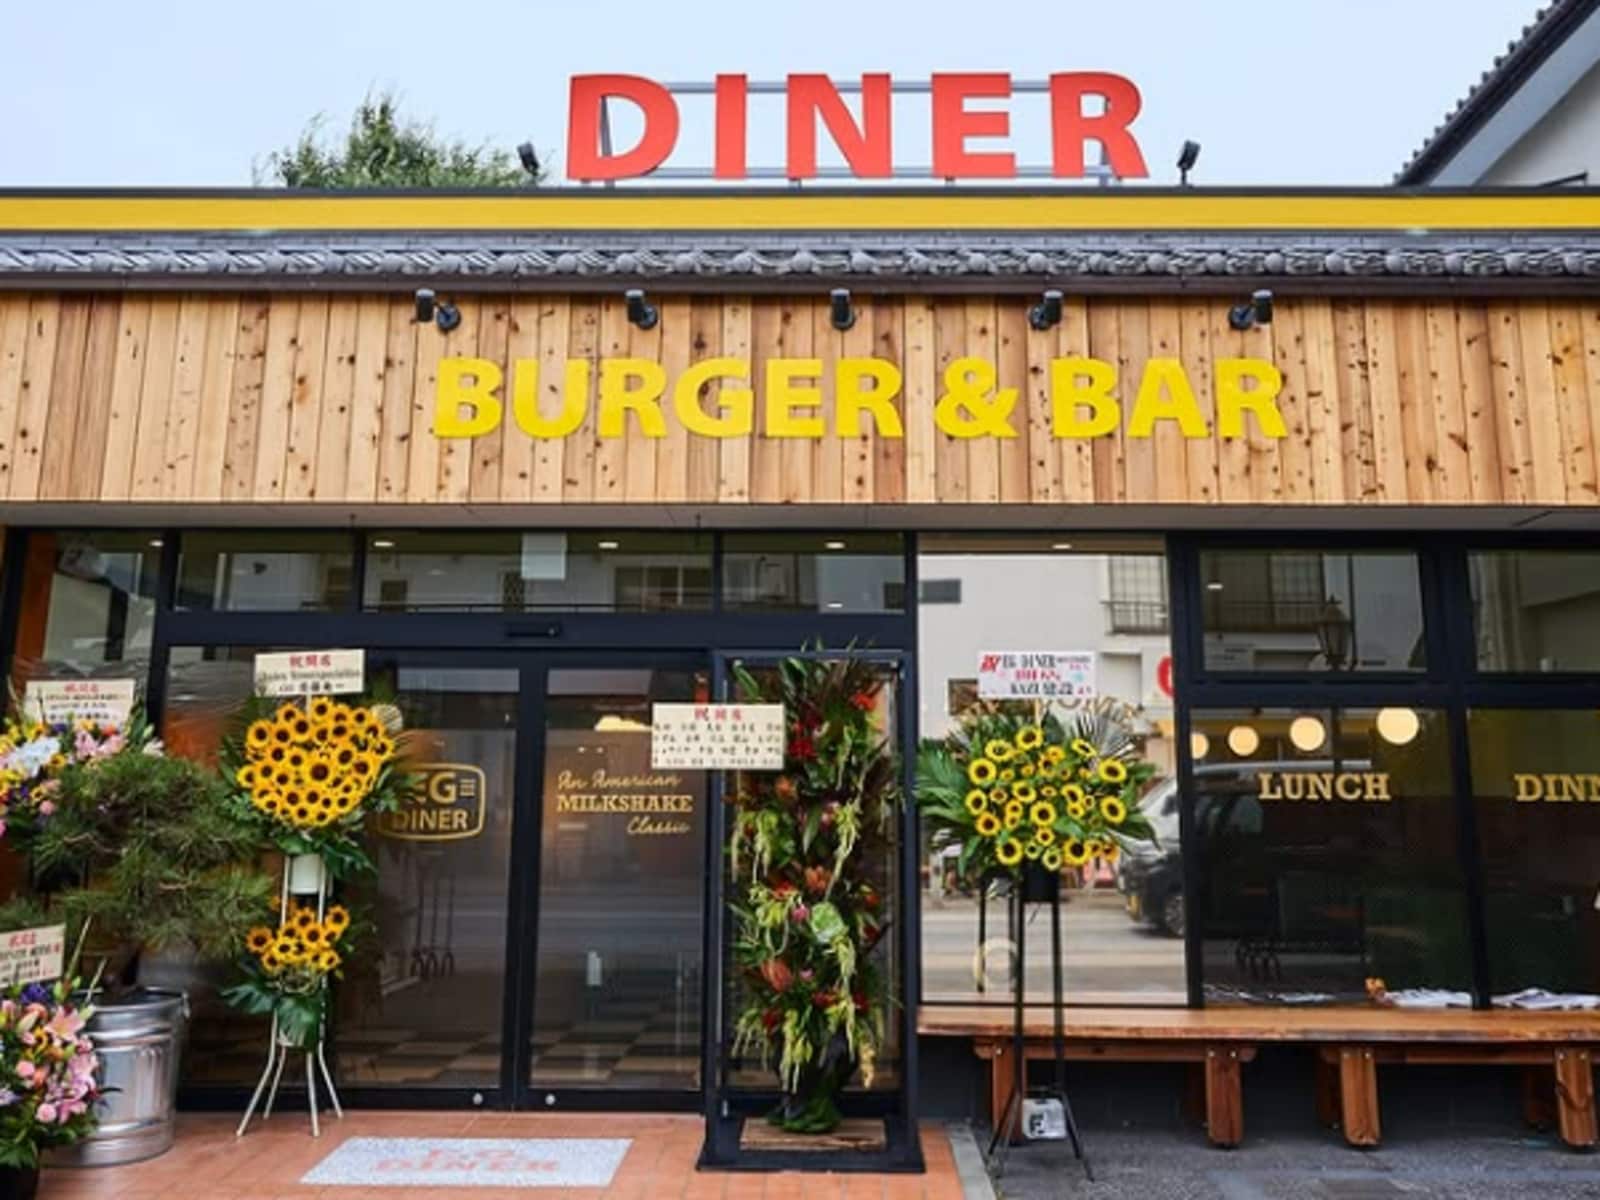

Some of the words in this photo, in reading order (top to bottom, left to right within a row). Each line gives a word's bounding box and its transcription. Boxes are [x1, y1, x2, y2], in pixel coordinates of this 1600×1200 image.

[566, 71, 1149, 181] DINER
[433, 357, 905, 440] BURGER
[933, 357, 1020, 440] &
[1050, 357, 1289, 440] BAR
[558, 770, 588, 790] An
[593, 768, 683, 788] American
[1258, 772, 1392, 800] LUNCH
[556, 794, 694, 813] MILKSHAKE
[392, 808, 468, 831] DINER
[627, 815, 692, 834] Classic
